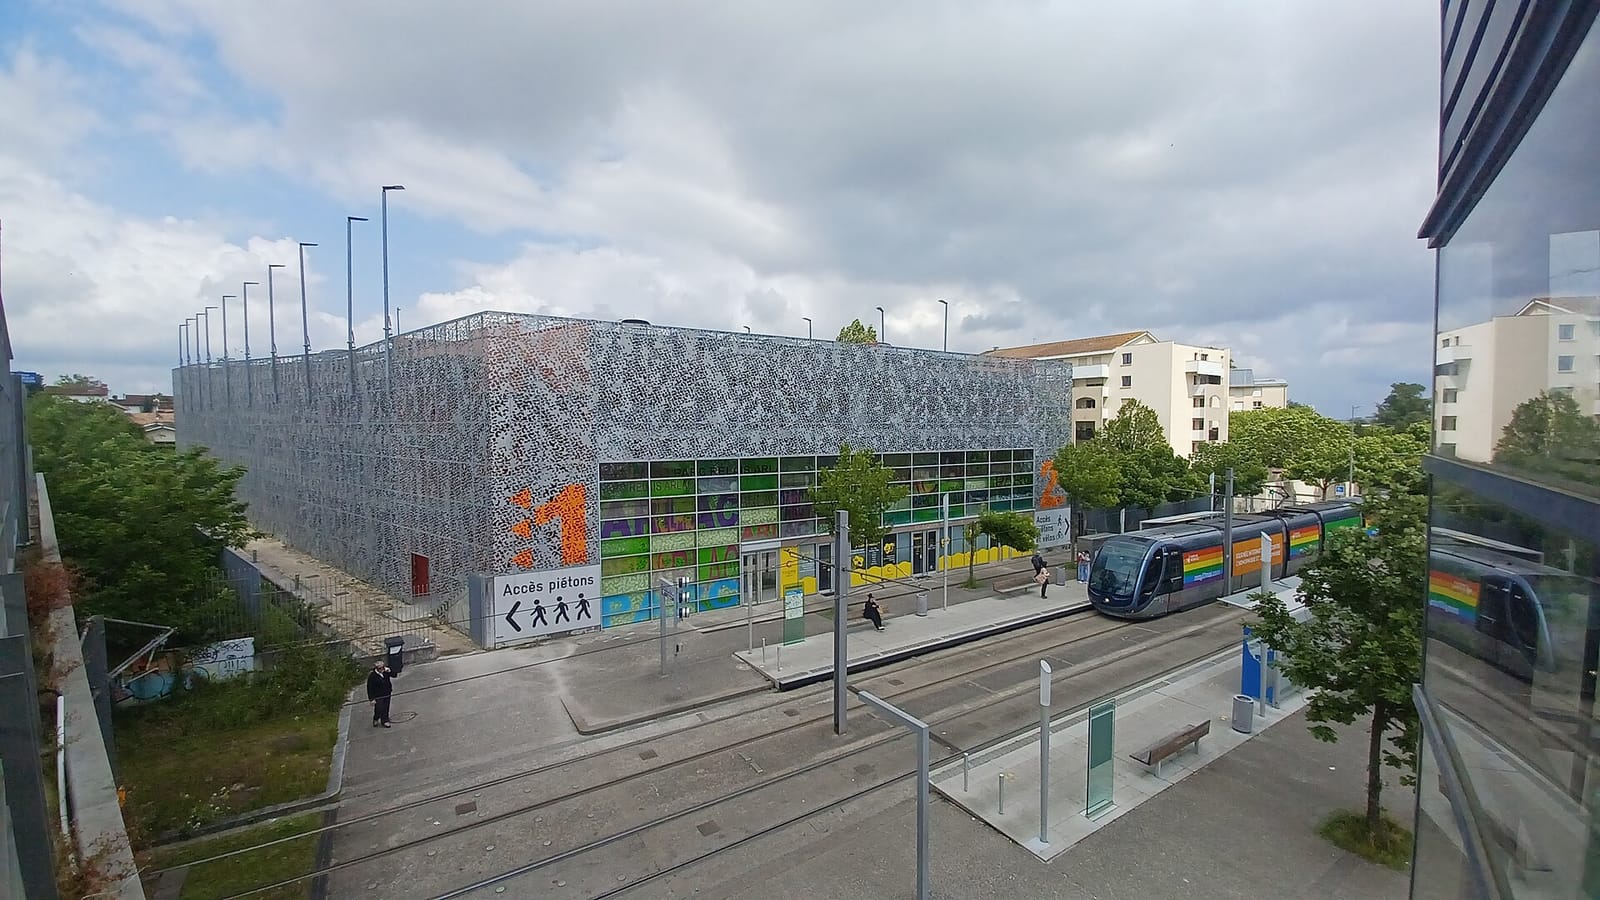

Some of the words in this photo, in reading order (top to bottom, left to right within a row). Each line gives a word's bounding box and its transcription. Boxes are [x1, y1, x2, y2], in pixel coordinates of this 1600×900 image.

[1040, 459, 1066, 508] 2
[533, 482, 588, 566] 1
[503, 581, 544, 597] Accès
[549, 576, 594, 594] piétons
